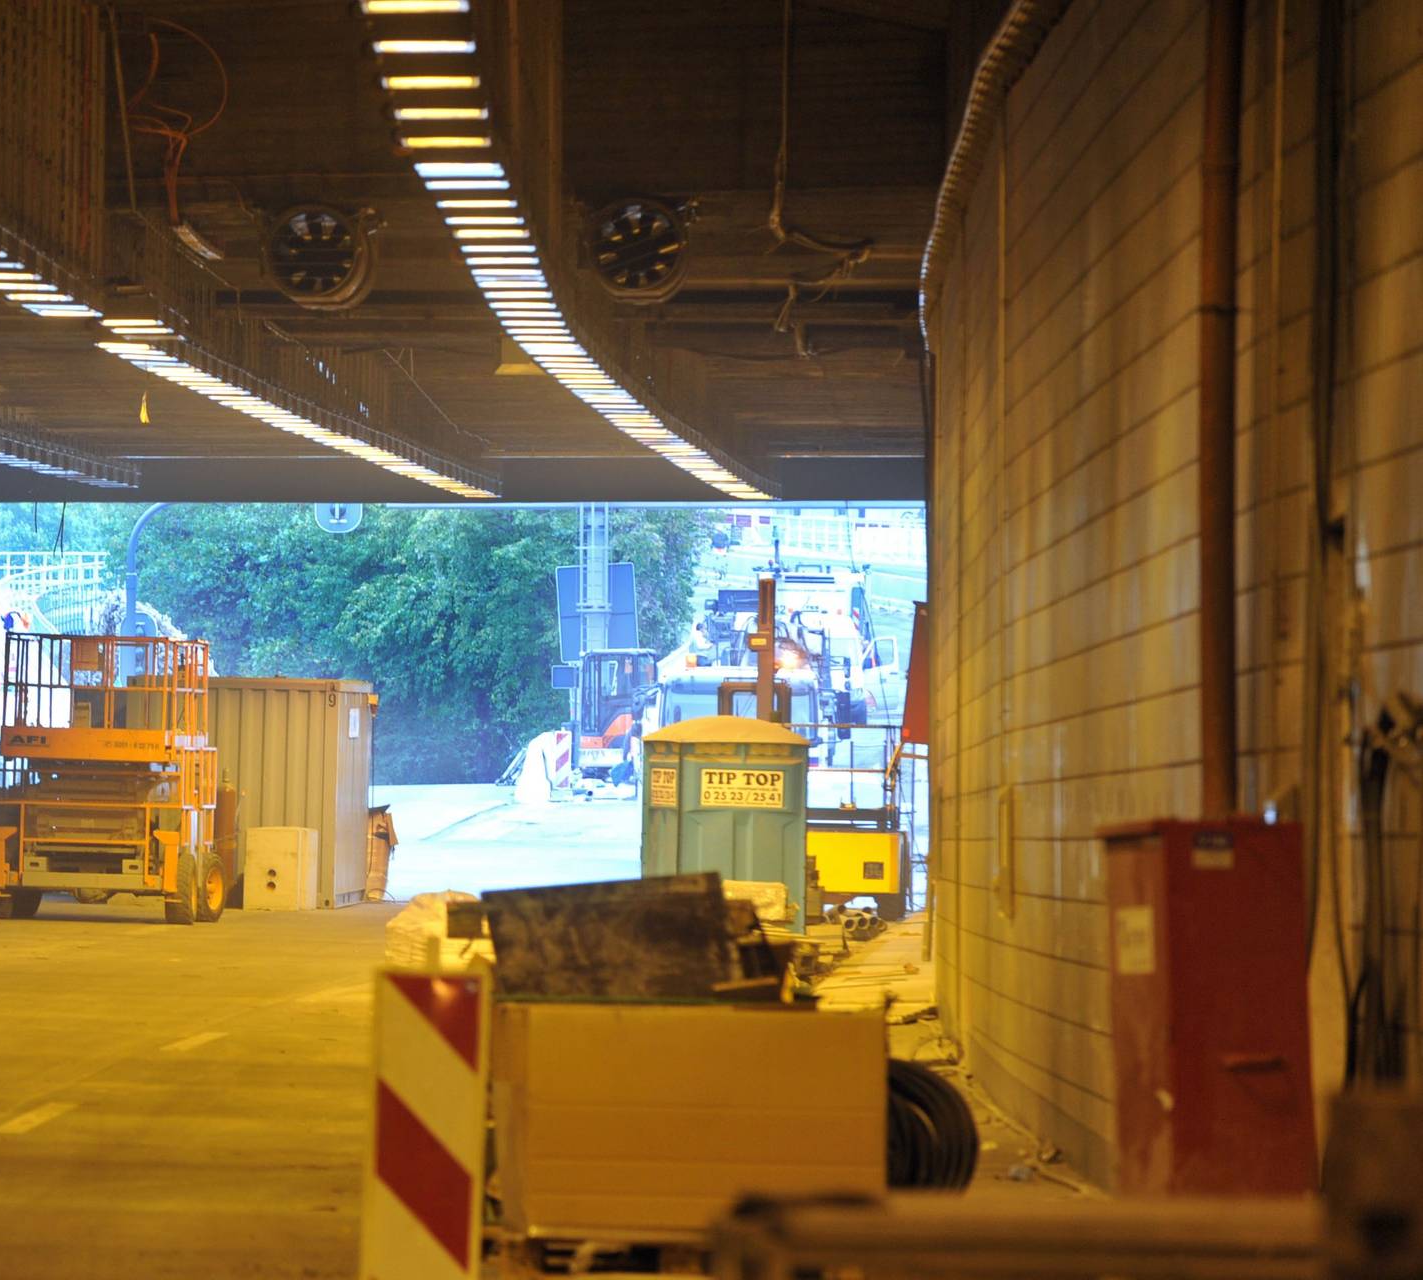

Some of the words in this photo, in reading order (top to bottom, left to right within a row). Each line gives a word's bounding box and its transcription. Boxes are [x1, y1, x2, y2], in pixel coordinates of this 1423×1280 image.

[704, 771, 737, 785] TIP
[742, 772, 781, 787] TOP
[703, 790, 711, 800] 0
[713, 791, 727, 801] 25
[730, 791, 743, 801] 23
[753, 792, 766, 802] 25
